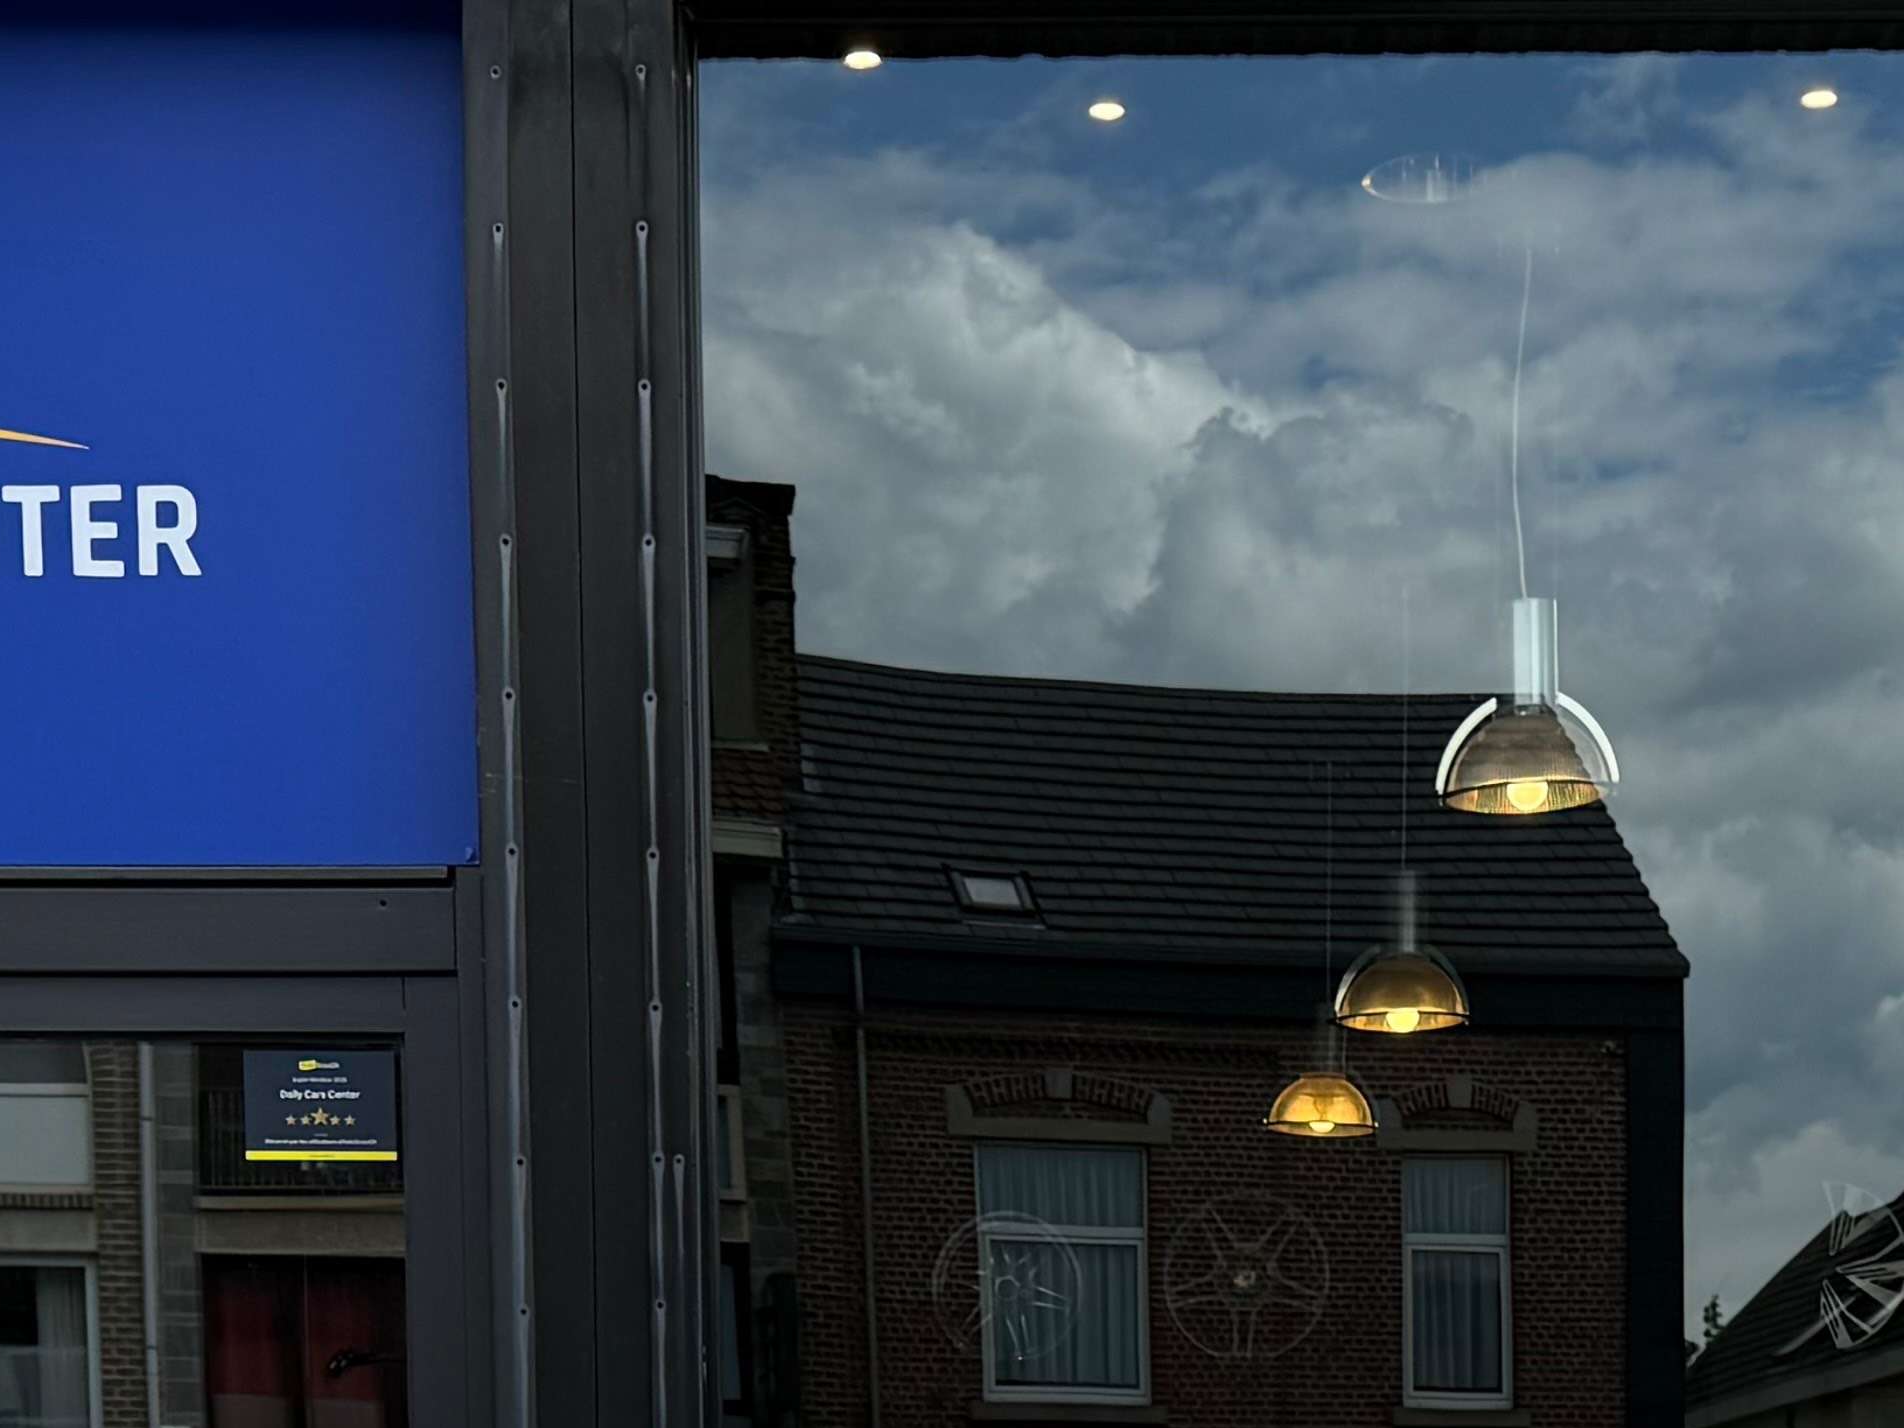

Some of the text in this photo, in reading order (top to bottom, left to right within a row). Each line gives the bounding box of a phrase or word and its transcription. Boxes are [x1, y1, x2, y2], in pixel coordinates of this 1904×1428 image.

[280, 1089, 360, 1100] Daily Cars Center
